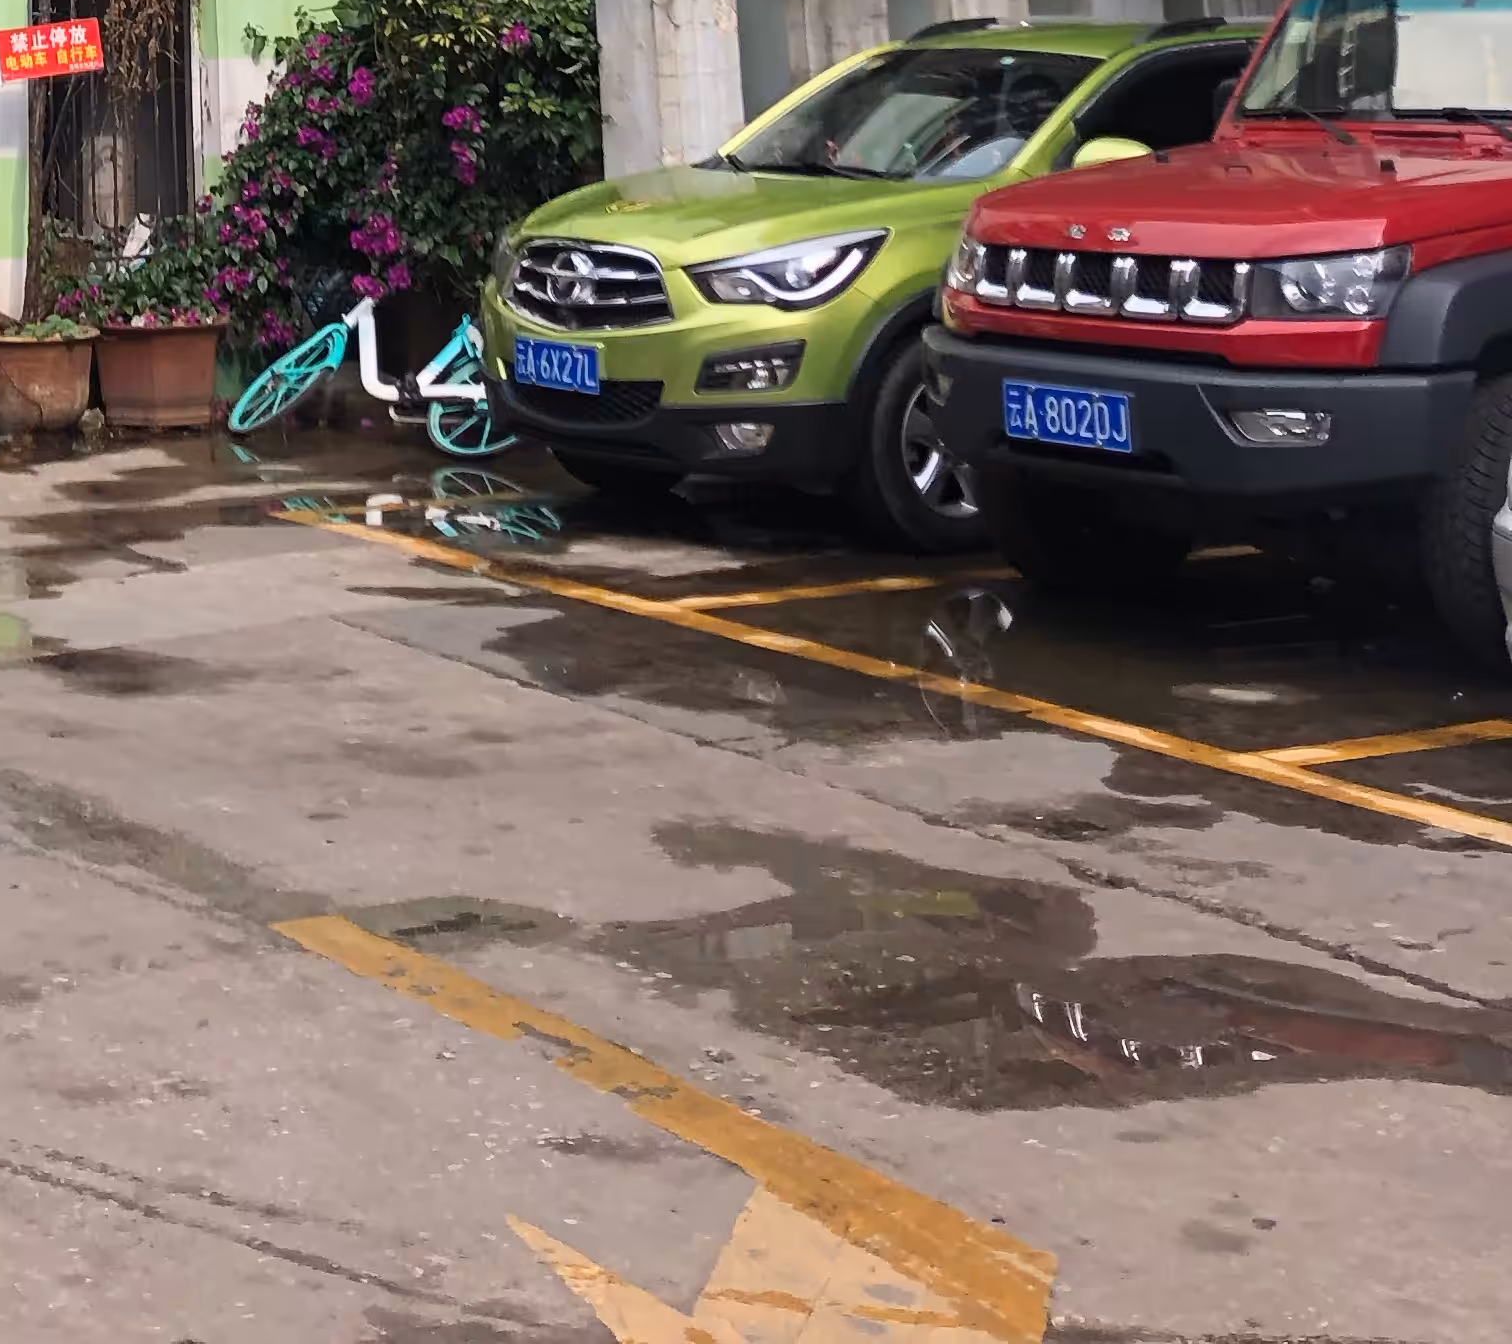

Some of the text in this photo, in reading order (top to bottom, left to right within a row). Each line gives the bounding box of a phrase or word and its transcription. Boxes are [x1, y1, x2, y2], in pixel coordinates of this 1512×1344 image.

[10, 24, 87, 53] 禁止停放
[6, 51, 48, 71] 电动车
[57, 44, 97, 65] 自行车
